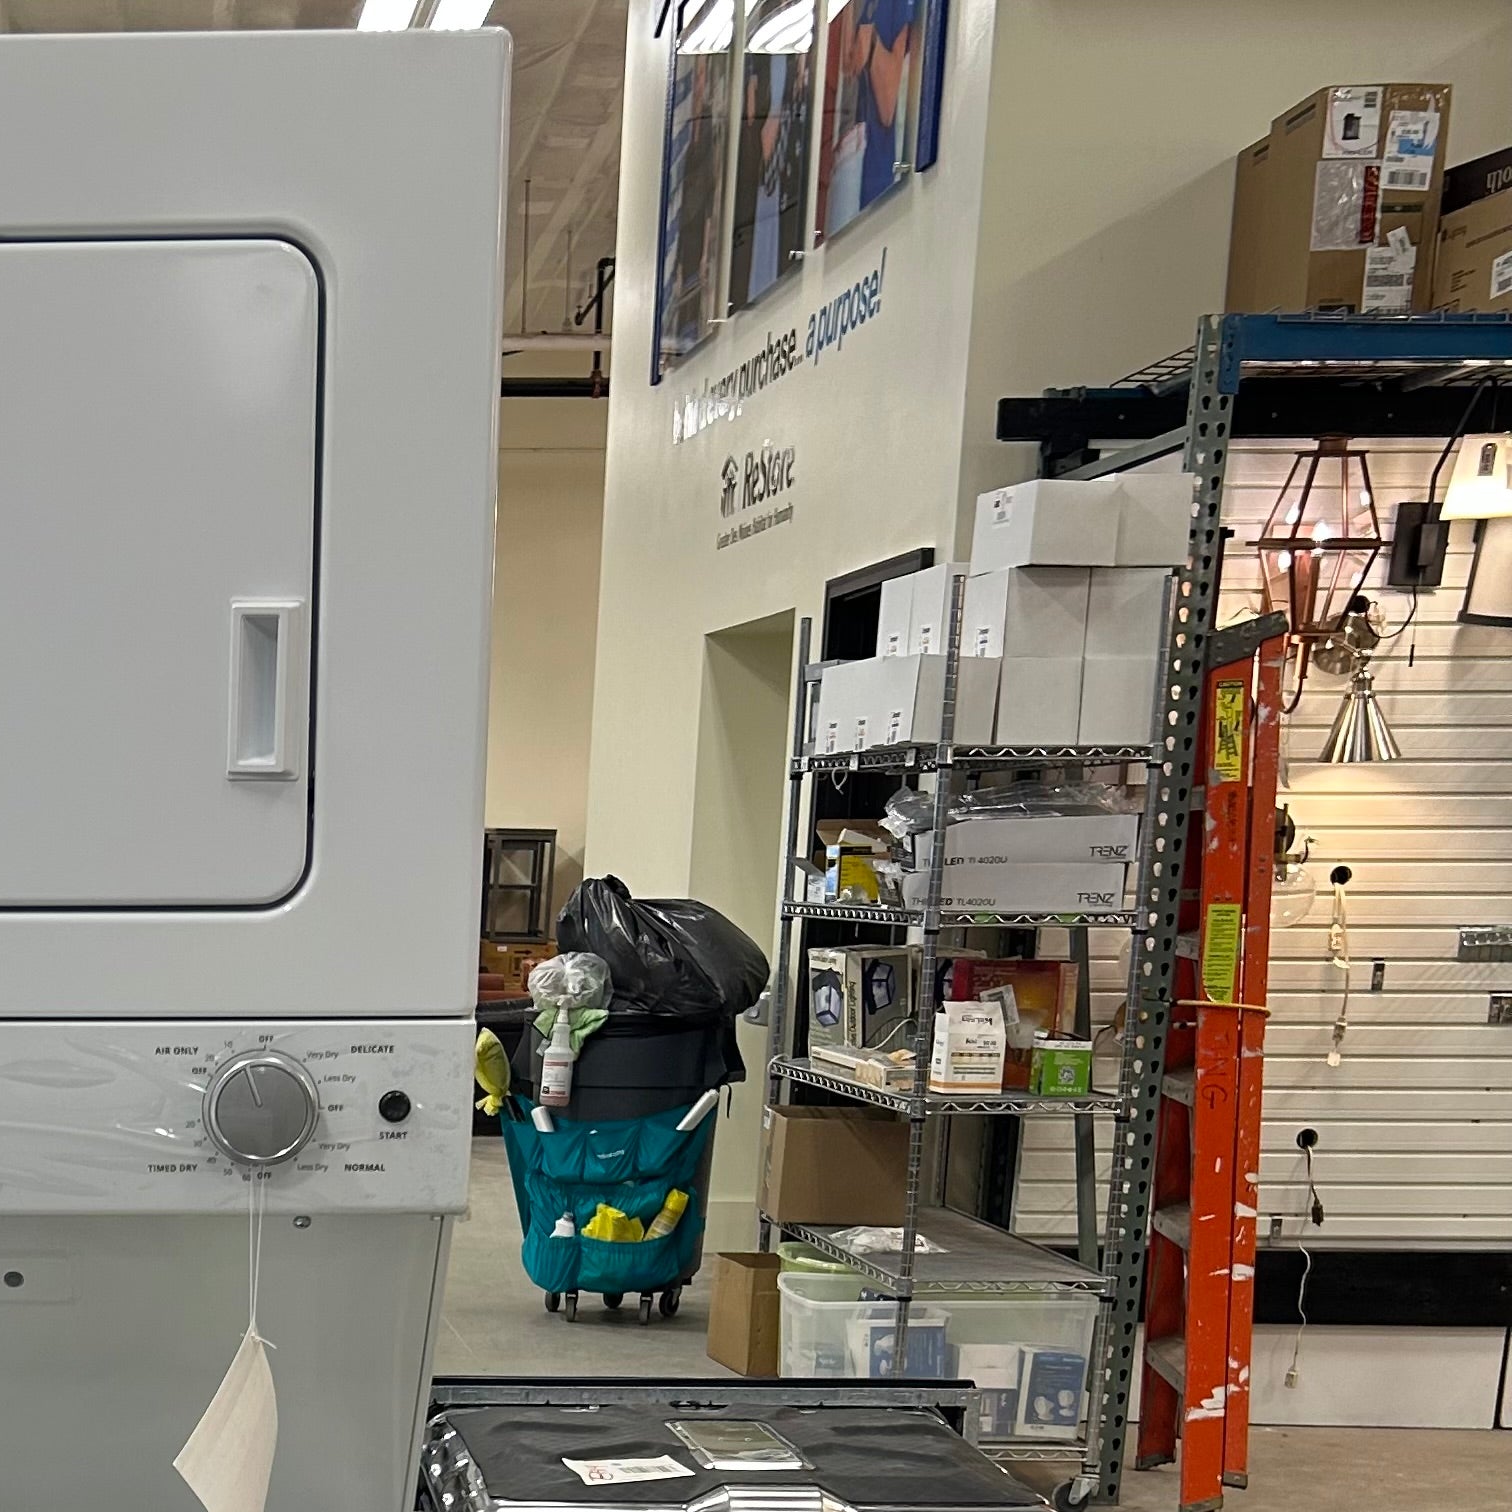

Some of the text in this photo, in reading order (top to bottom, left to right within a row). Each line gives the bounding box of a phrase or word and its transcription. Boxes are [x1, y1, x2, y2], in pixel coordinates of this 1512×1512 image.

[805, 313, 817, 359] a
[812, 247, 888, 366] purpose!
[1089, 845, 1131, 858] TRENZ
[1076, 892, 1116, 905] TRENZ
[258, 1035, 274, 1043] OFF
[155, 1047, 199, 1055] AIR ONLY
[350, 1045, 395, 1054] DELICATE
[307, 1050, 339, 1060] Very Dry
[191, 1067, 207, 1075] OFF
[323, 1074, 356, 1083] Less Dry
[327, 1104, 344, 1112] OFF
[379, 1131, 407, 1140] START
[319, 1142, 350, 1151] Very Dry
[148, 1164, 198, 1173] TIMED DRY
[297, 1163, 328, 1173] Less Dry
[344, 1164, 386, 1172] NORMAL
[257, 1172, 273, 1180] OFF
